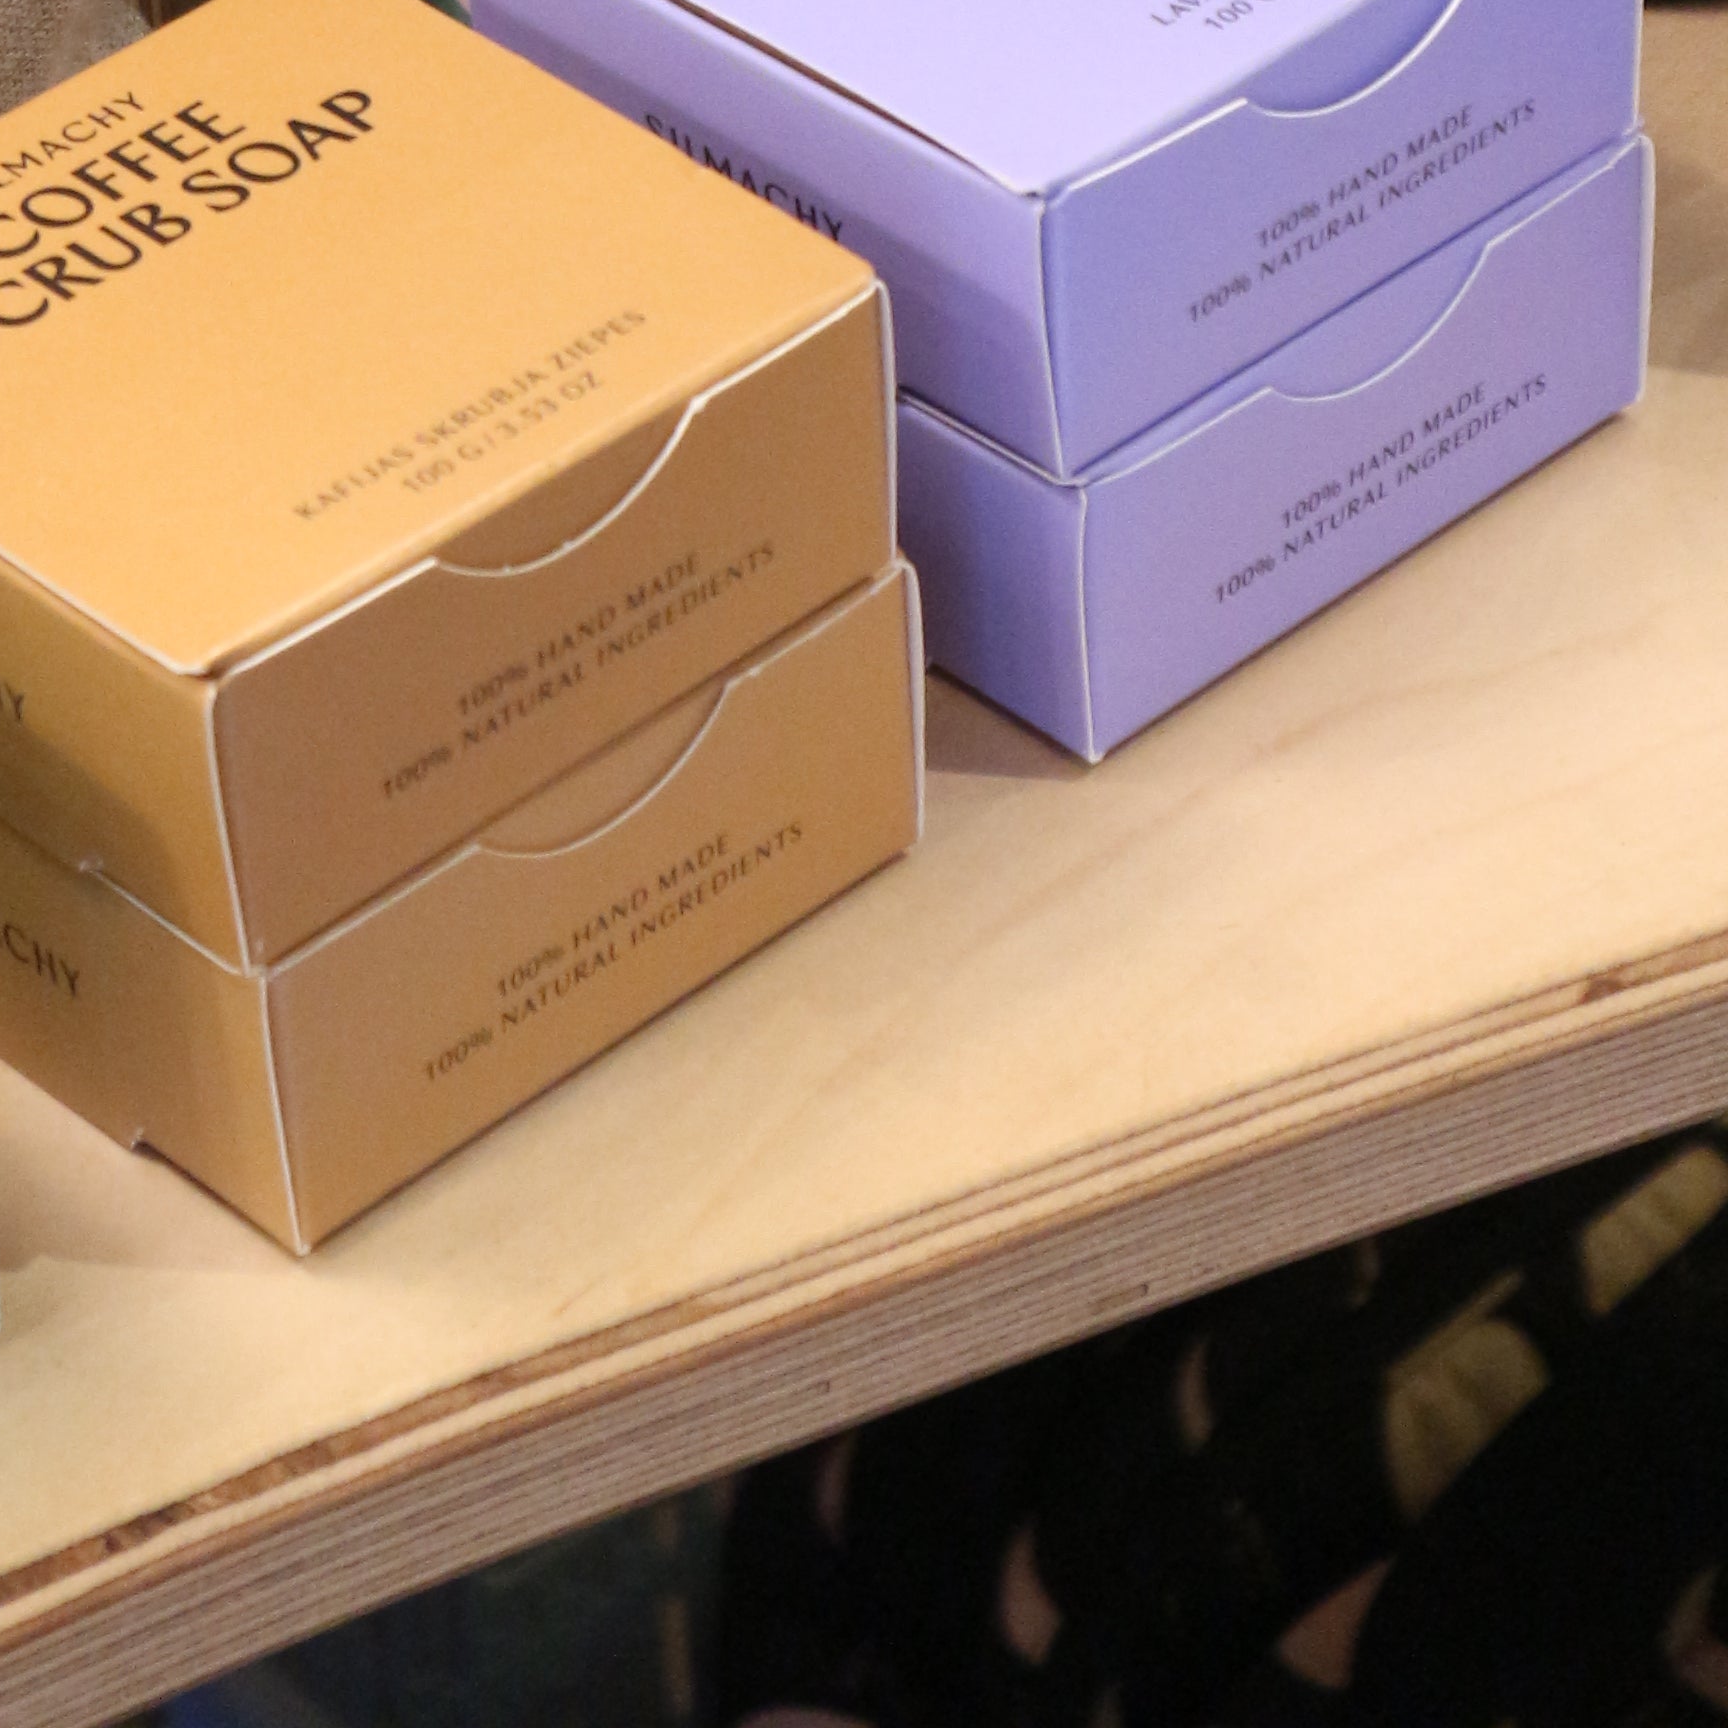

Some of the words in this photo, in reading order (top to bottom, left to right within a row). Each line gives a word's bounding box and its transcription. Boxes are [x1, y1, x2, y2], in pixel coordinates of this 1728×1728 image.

[1205, 0, 1254, 30] 100
[180, 89, 374, 214] SOAP
[1258, 205, 1370, 280] NATURAL
[1378, 99, 1537, 209] INGREDIENTS
[1328, 152, 1399, 208] HAND
[1407, 104, 1473, 161] MADE
[1282, 487, 1390, 563] NATURAL
[1397, 374, 1548, 487] INGREDIENTS
[1349, 429, 1415, 487] HAND
[1422, 380, 1487, 437] MADE
[460, 660, 584, 749] NATURAL
[596, 541, 776, 668] INGREDIENTS
[535, 604, 617, 669] HAND
[625, 551, 700, 612] MADE
[499, 943, 618, 1034] NATURAL
[629, 820, 806, 946] INGREDIENTS
[573, 884, 650, 950] HAND
[657, 833, 730, 896] MADE
